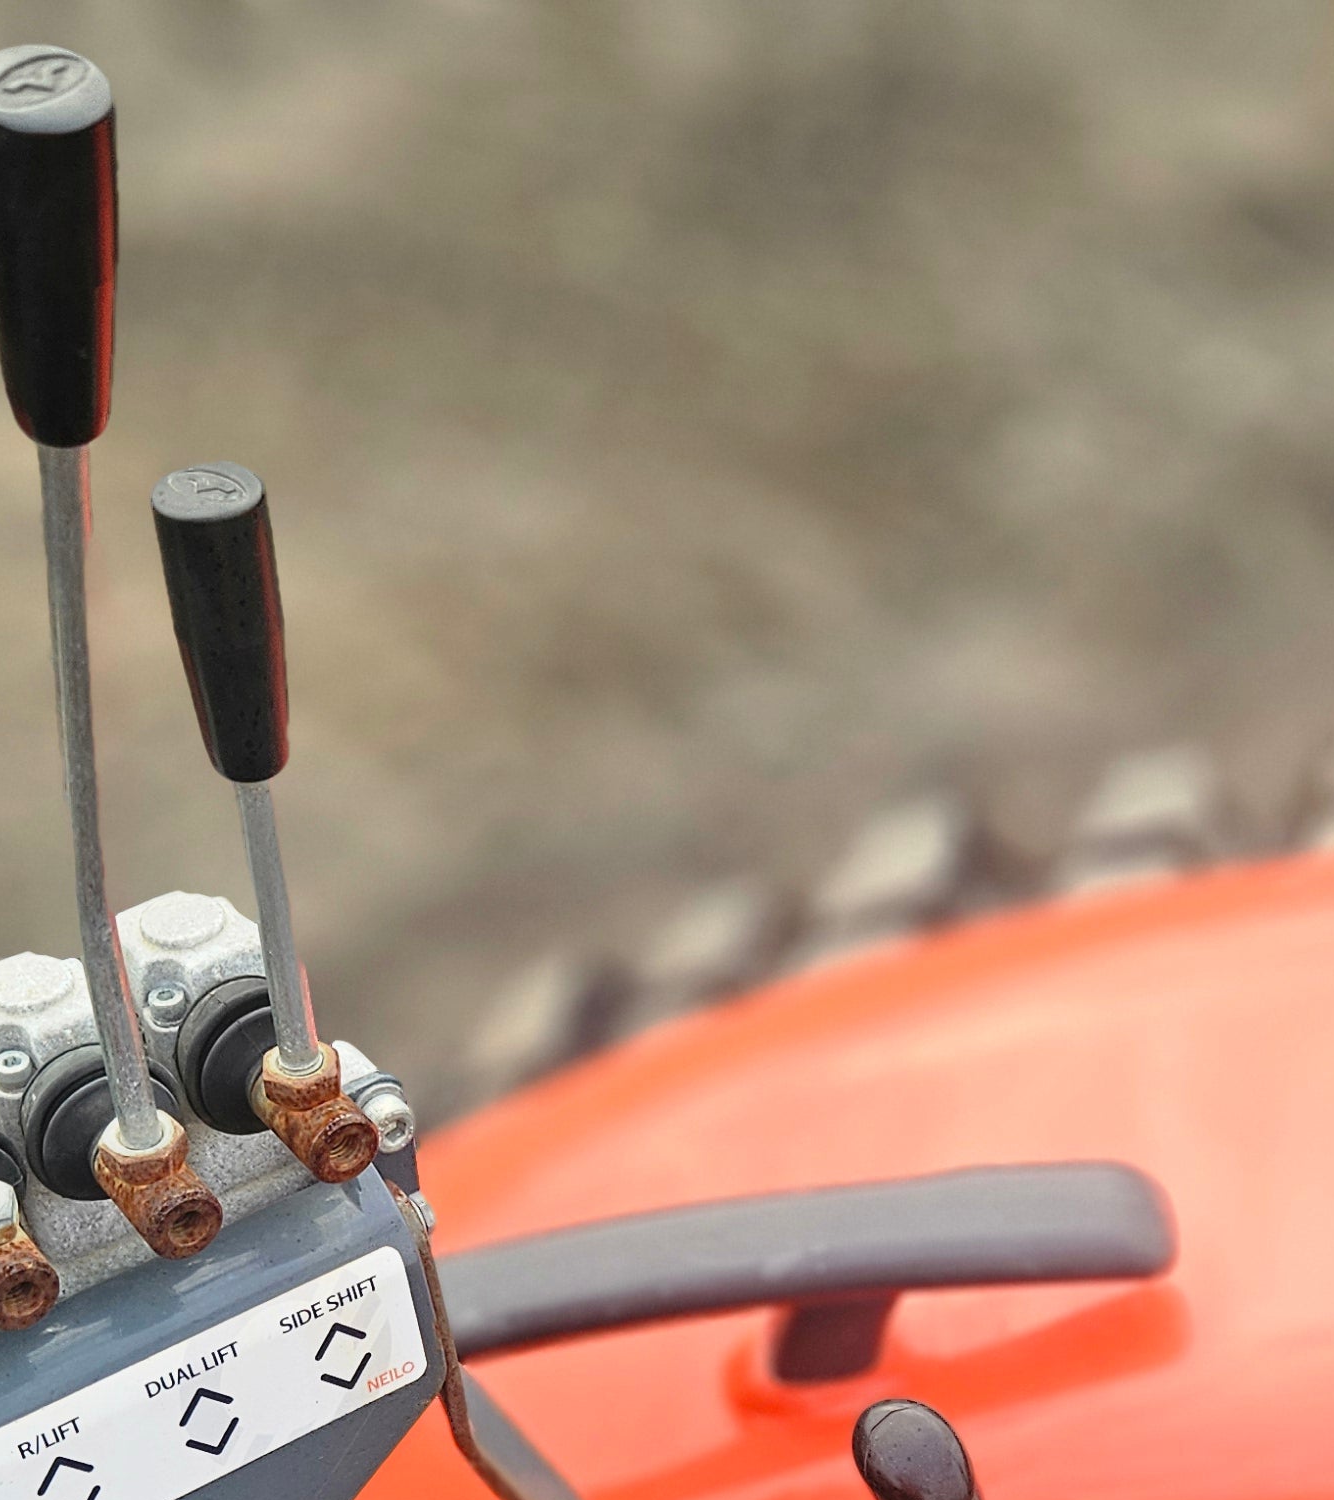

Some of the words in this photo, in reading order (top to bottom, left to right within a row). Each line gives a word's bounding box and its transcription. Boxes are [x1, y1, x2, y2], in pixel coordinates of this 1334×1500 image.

[279, 1301, 325, 1334] SIDE
[326, 1275, 376, 1312] SHIFT
[144, 1363, 200, 1399] DUAL
[201, 1341, 239, 1372] LIFT
[366, 1361, 416, 1392] NEILO
[17, 1416, 81, 1460] R/LIFT
